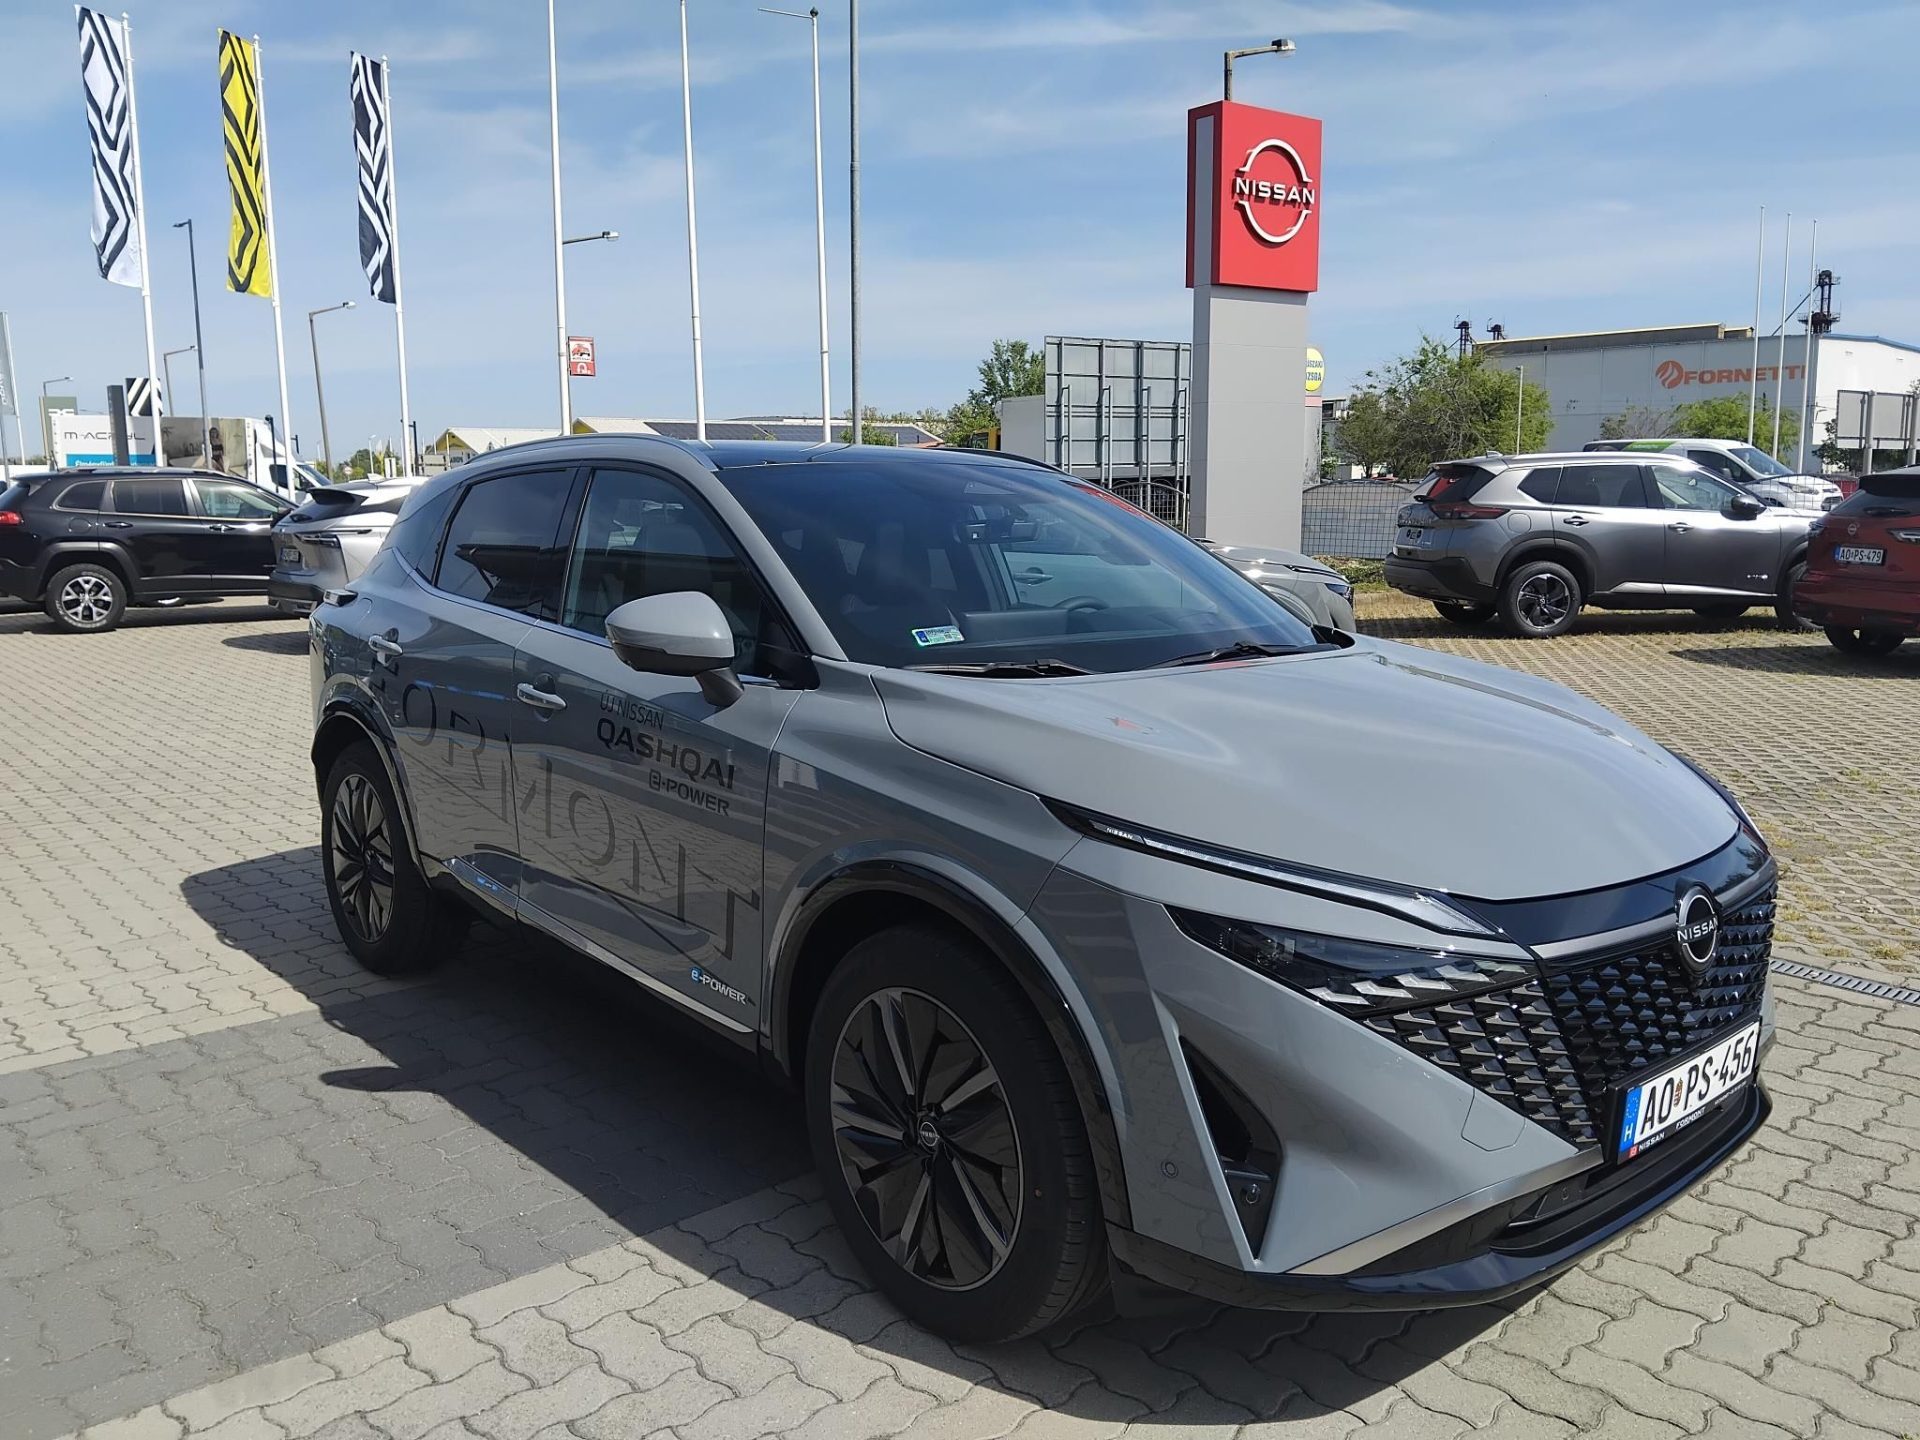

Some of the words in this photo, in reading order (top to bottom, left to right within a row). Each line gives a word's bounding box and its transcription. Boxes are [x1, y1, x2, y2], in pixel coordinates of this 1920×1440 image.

[1236, 177, 1315, 205] NISSAN
[1683, 364, 1806, 385] FORNETTI
[600, 690, 615, 712] ÚJ
[617, 700, 665, 731] NISSAN
[596, 717, 736, 790] QASHQAI
[1106, 827, 1134, 840] NISSAN
[1677, 917, 1718, 942] NISSAN
[691, 968, 746, 1005] e-POWER
[1683, 1029, 1756, 1112] PS-456
[1623, 1122, 1634, 1142] H
[1638, 1131, 1666, 1151] NISSAN
